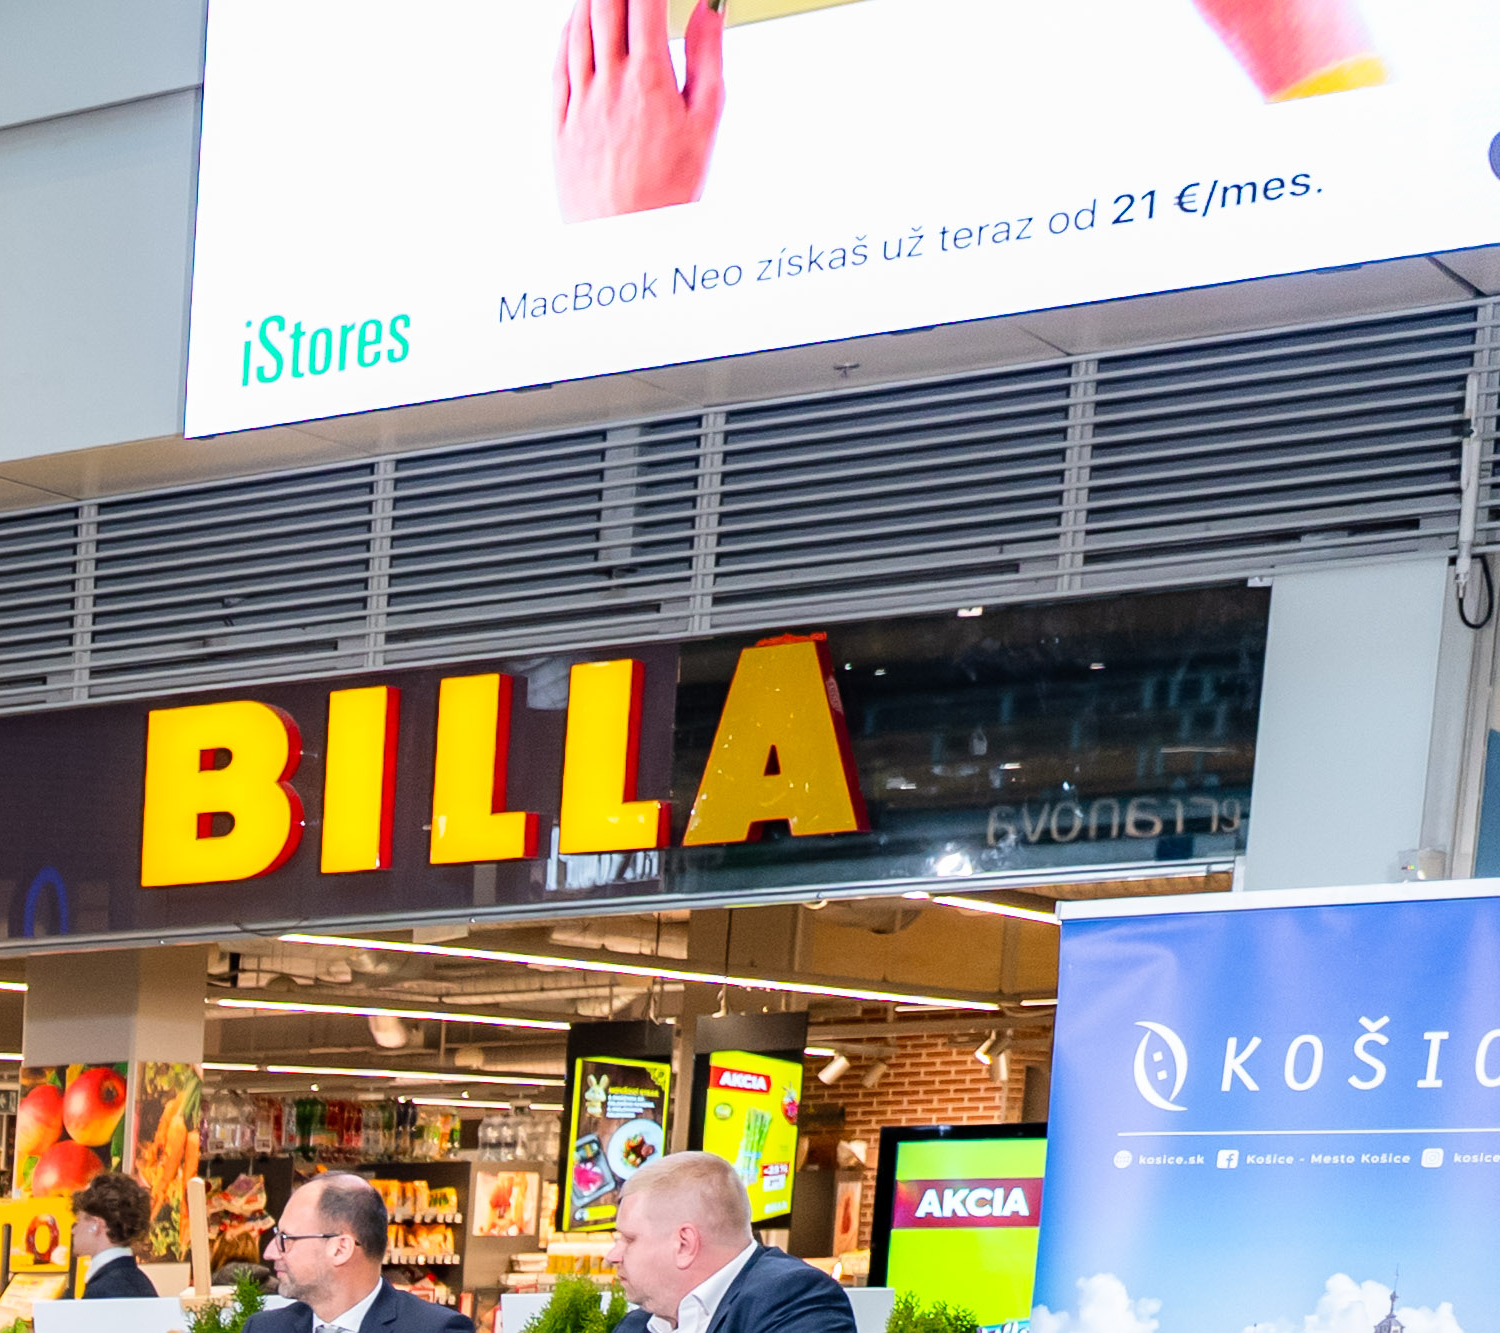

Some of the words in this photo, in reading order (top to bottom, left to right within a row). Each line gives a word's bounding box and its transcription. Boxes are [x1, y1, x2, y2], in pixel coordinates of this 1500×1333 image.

[498, 268, 659, 325] MacBook
[672, 256, 744, 298] Neo
[755, 237, 870, 283] získaš
[881, 224, 926, 266] už
[936, 209, 1035, 254] teraz
[1046, 199, 1099, 238] od
[1110, 190, 1160, 228] 21
[1174, 164, 1324, 216] €/mes.
[240, 308, 413, 388] iStores
[140, 631, 871, 887] BILLA
[719, 1070, 768, 1092] AKCIA
[1138, 1152, 1206, 1167] kosice.sk
[1246, 1150, 1295, 1167] Košice
[1310, 1151, 1355, 1166] Mesto
[1359, 1149, 1411, 1166] Košice
[913, 1187, 1030, 1219] AKCIA
